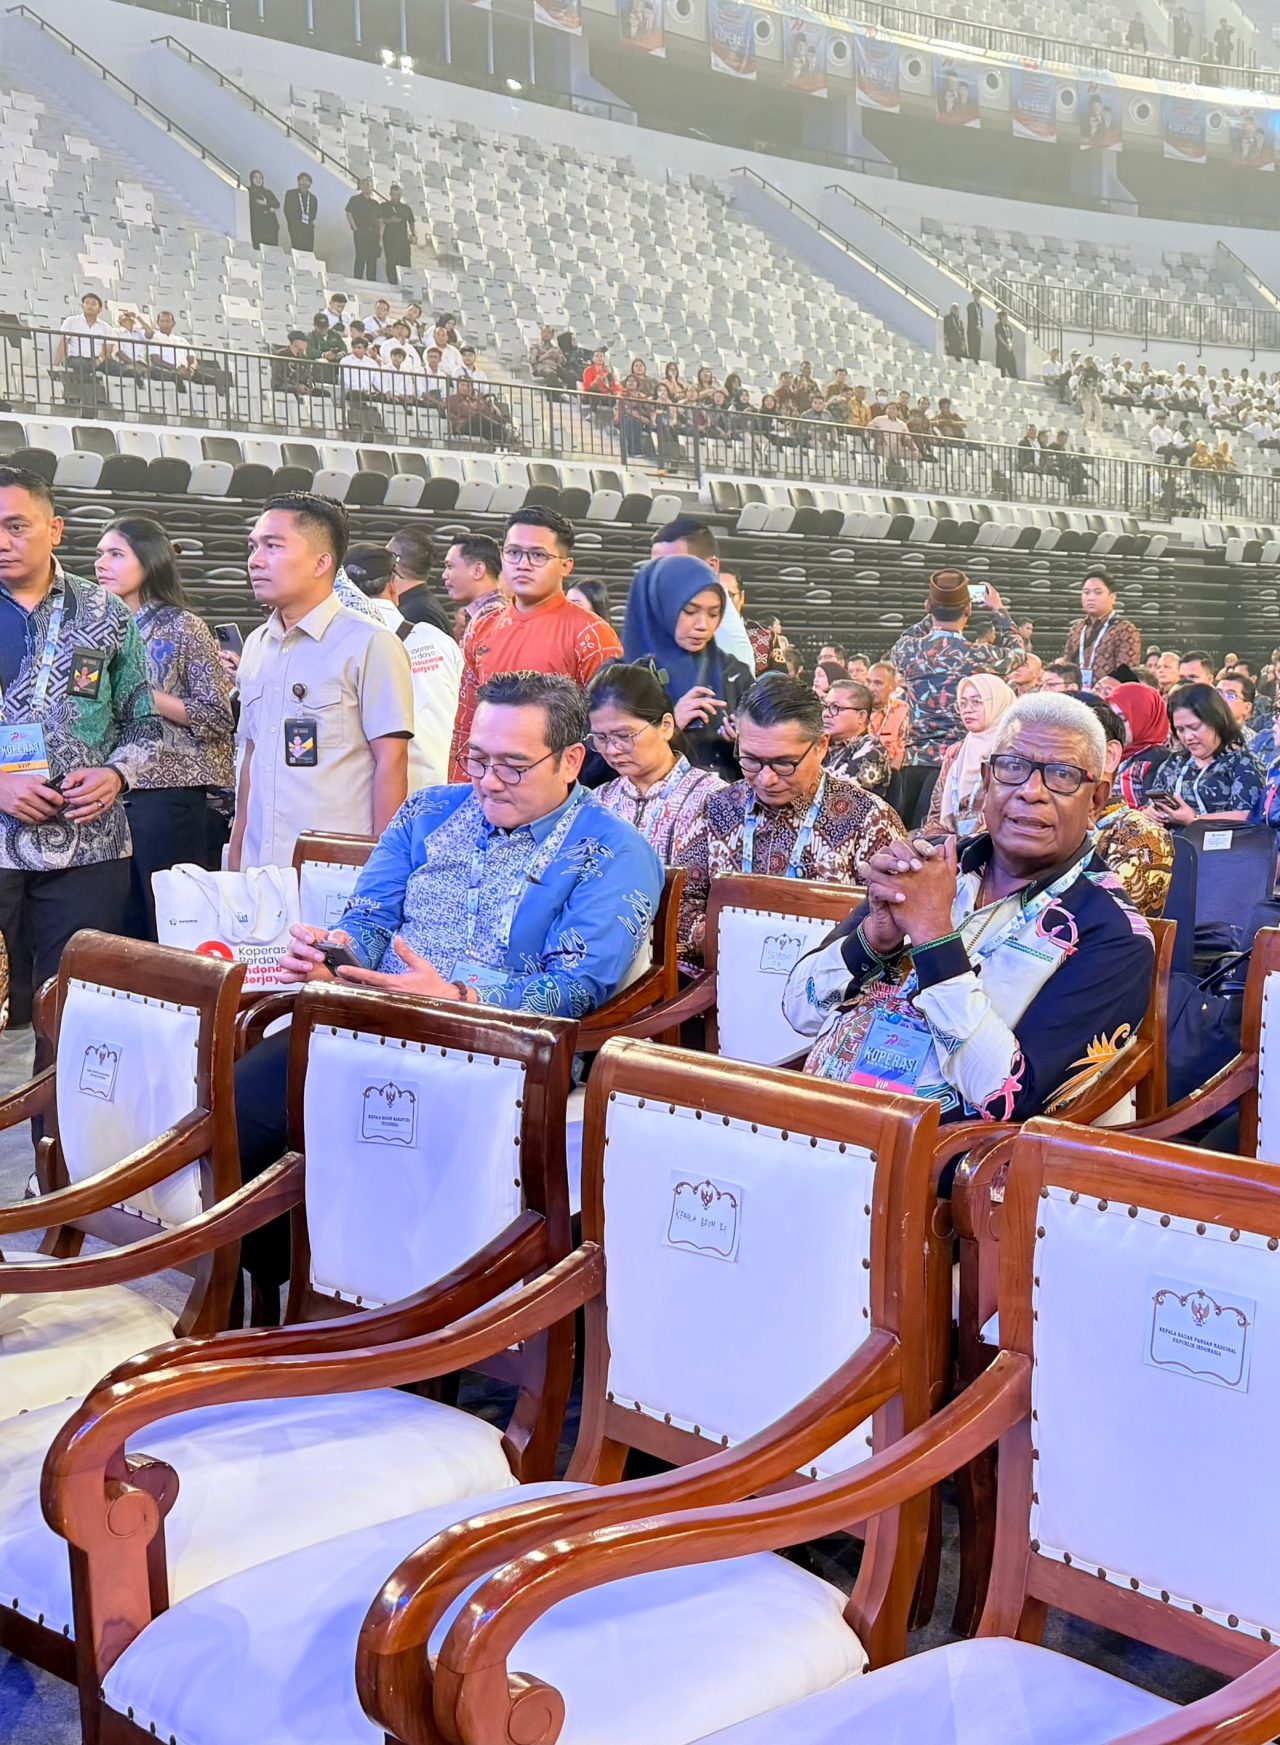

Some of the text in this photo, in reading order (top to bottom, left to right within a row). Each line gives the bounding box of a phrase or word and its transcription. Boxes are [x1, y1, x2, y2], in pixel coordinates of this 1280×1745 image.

[239, 957, 279, 966] Berday
[243, 974, 280, 986] Berjay
[864, 1046, 919, 1073] KOPERASI
[875, 1079, 889, 1089] VIP
[1159, 1326, 1177, 1337] KEPALA
